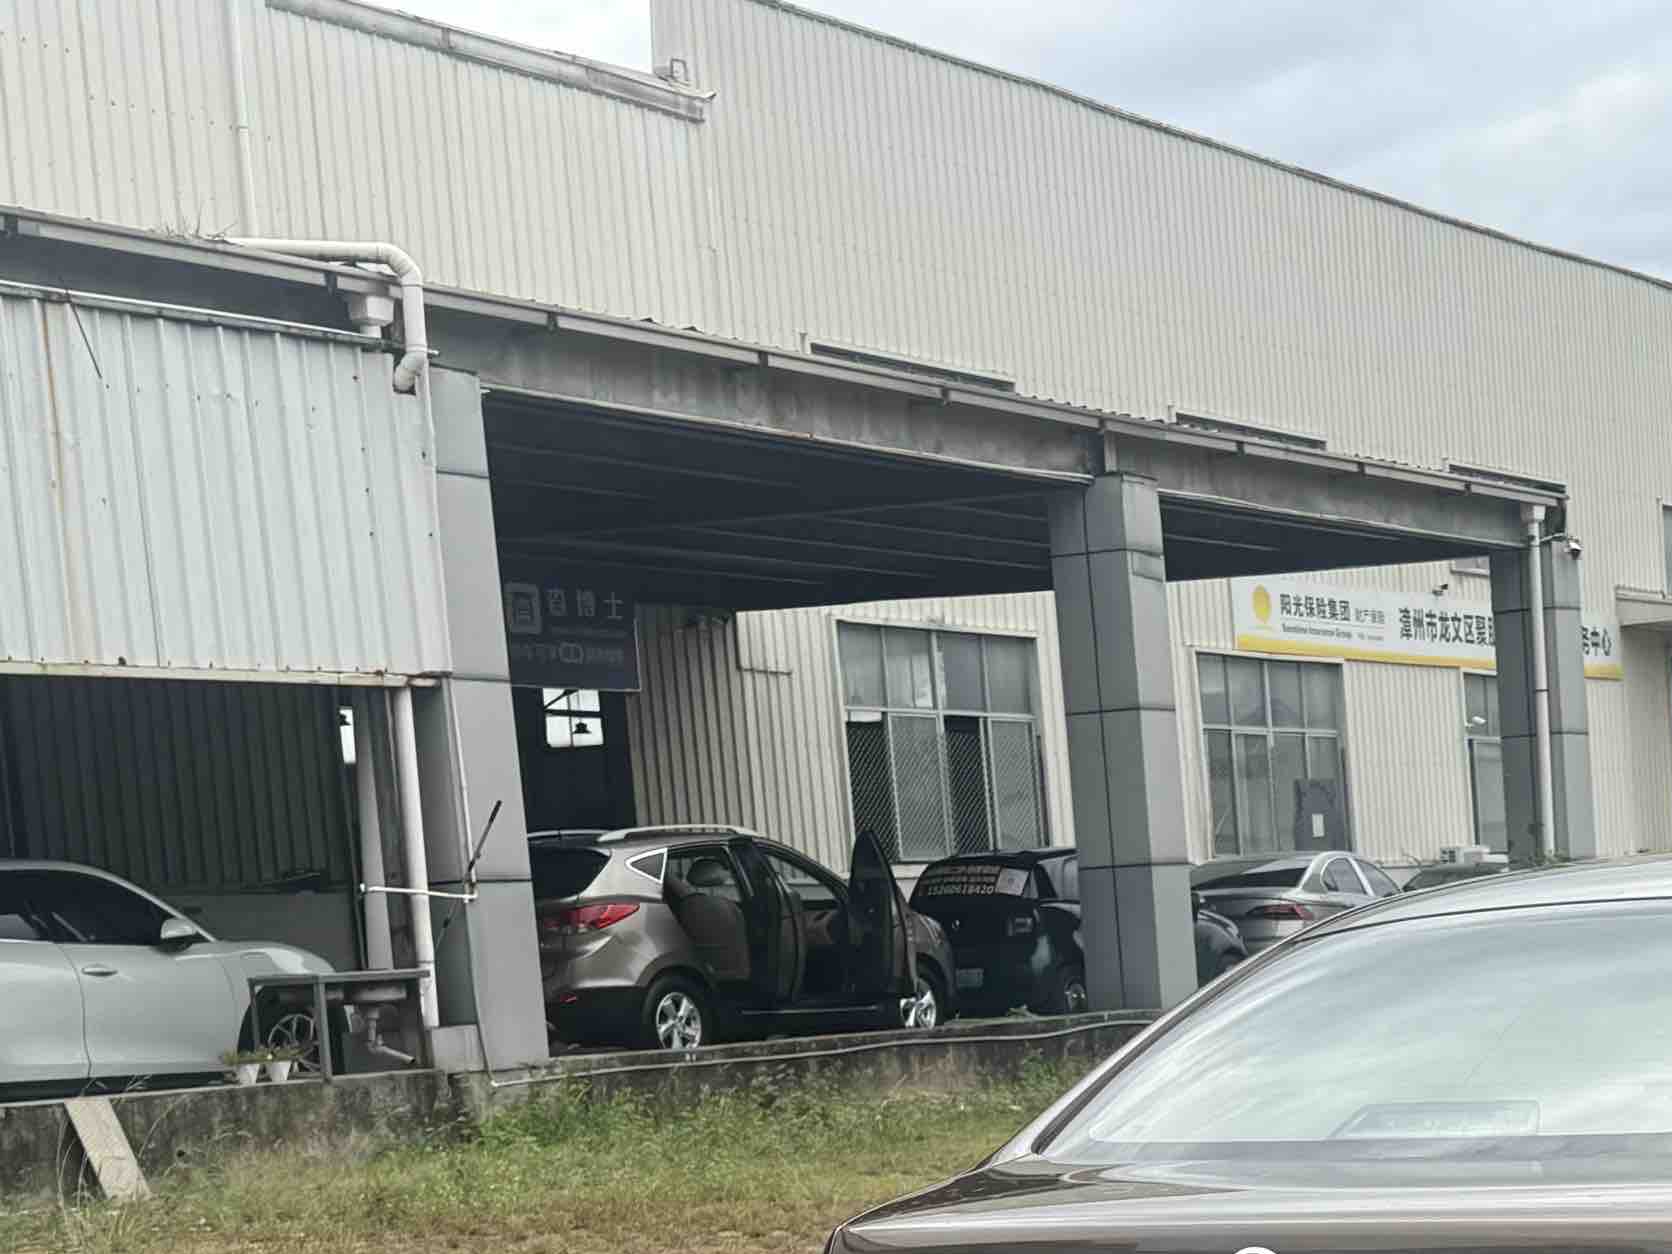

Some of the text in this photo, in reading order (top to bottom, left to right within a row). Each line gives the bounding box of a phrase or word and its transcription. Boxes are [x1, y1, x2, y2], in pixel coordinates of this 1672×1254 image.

[1280, 594, 1351, 621] 阳光保险集团
